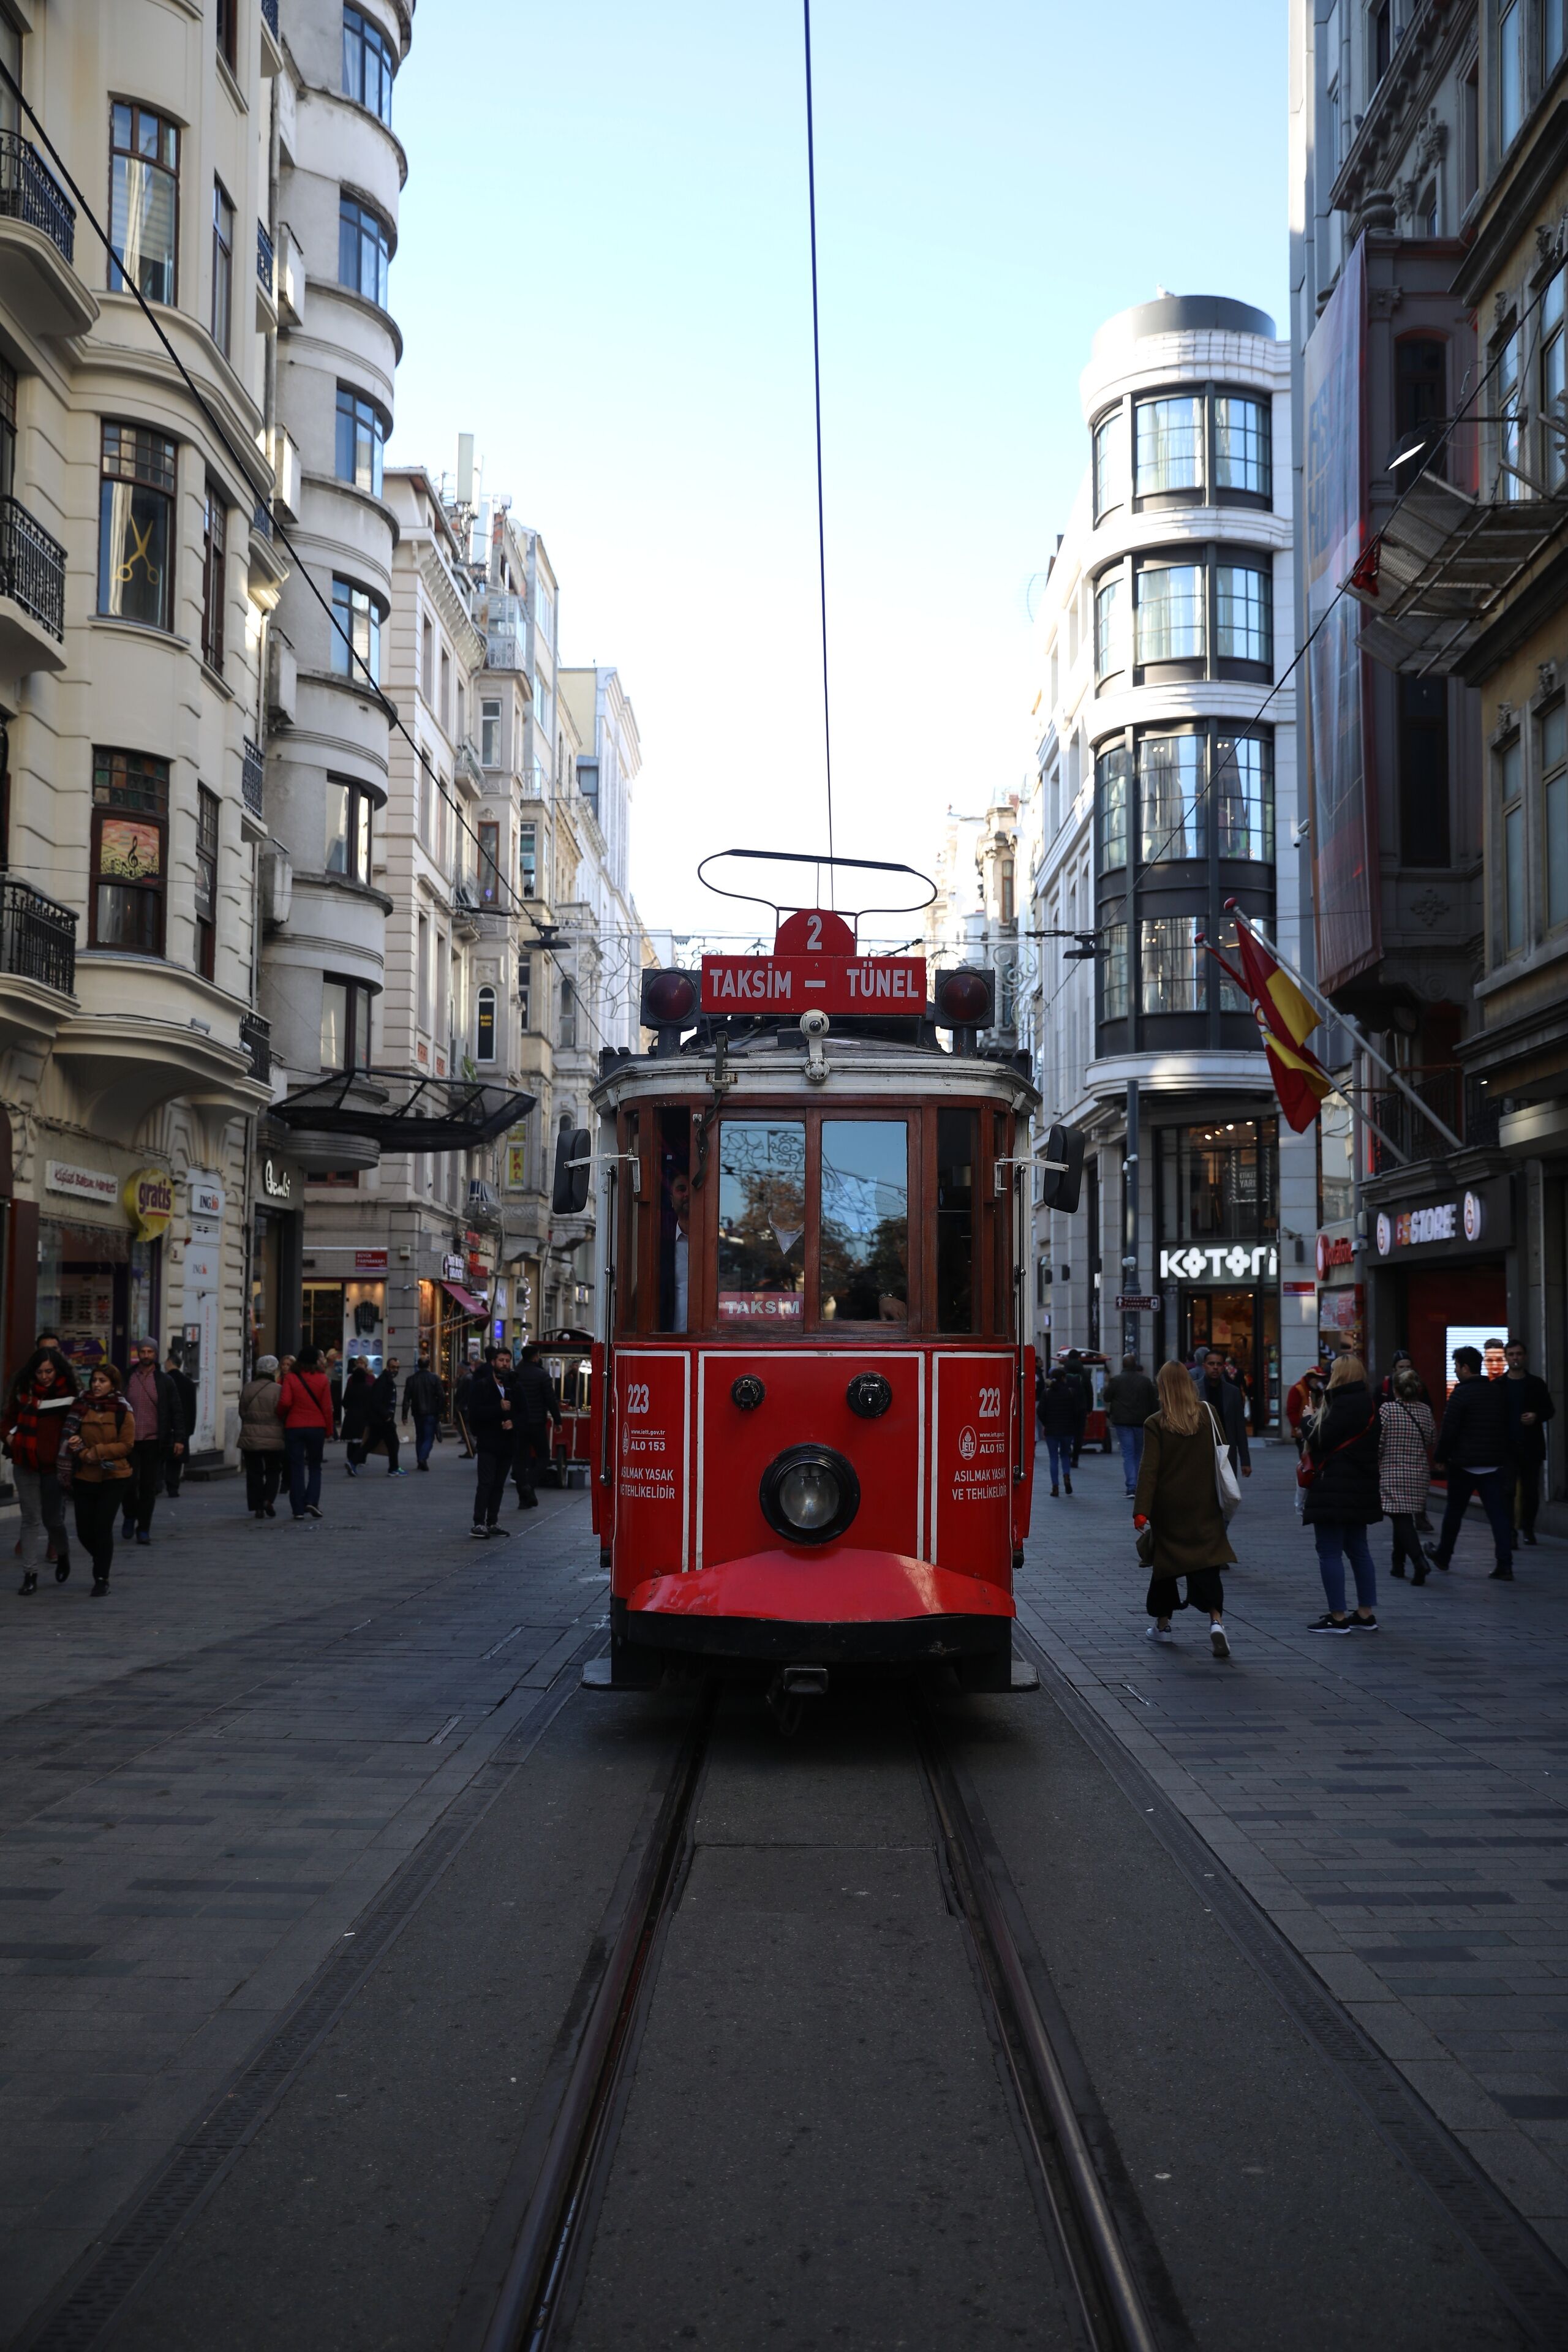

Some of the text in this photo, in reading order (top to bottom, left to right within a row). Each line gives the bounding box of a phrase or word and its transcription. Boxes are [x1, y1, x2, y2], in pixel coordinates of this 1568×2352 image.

[807, 915, 823, 950] 2
[709, 962, 792, 999] TAKSİM
[846, 961, 919, 998] TÜNEL
[138, 1178, 172, 1214] gratis
[200, 1195, 211, 1210] ING
[1160, 1245, 1277, 1278] KOTON
[725, 1298, 799, 1314] TAKSİM
[627, 1384, 649, 1414] 223
[979, 1387, 1000, 1417] 223
[631, 1441, 665, 1451] ALO 153
[980, 1443, 1005, 1453] ALO 153
[621, 1466, 674, 1481] ASILMAK YASAK
[954, 1468, 1006, 1482] ASILMAK YASAK
[620, 1483, 675, 1499] VE TEHLİKELİDİR
[952, 1483, 1006, 1501] VE TEHLİKELİDİR
